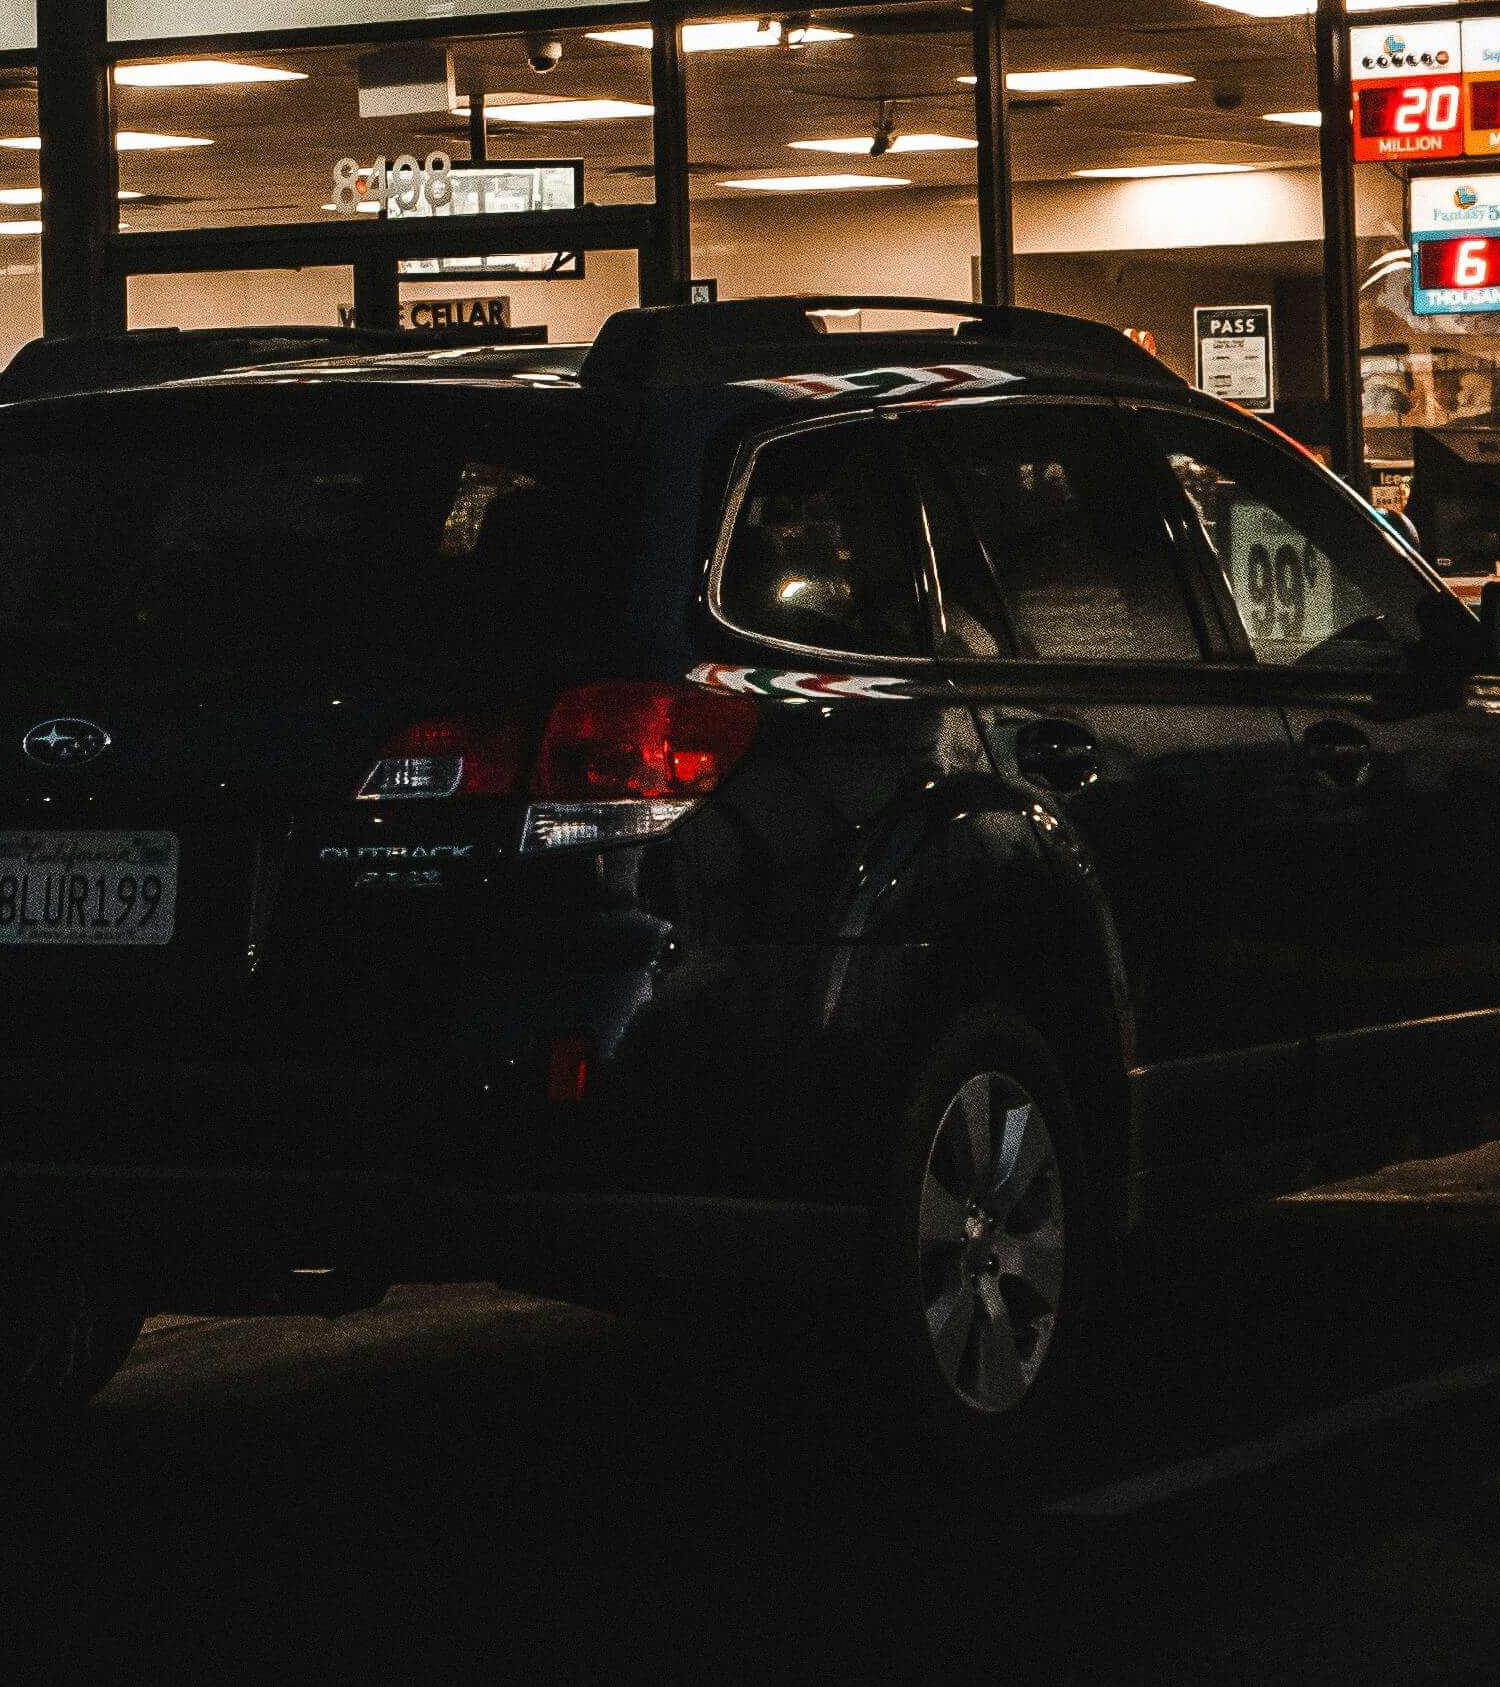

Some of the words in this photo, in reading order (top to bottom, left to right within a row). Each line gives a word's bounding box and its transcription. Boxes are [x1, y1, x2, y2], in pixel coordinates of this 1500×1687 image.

[1394, 85, 1460, 134] 20
[1379, 136, 1443, 153] MILLION
[331, 150, 453, 214] 8498
[410, 300, 504, 330] CELLAR
[1210, 318, 1256, 334] PASS
